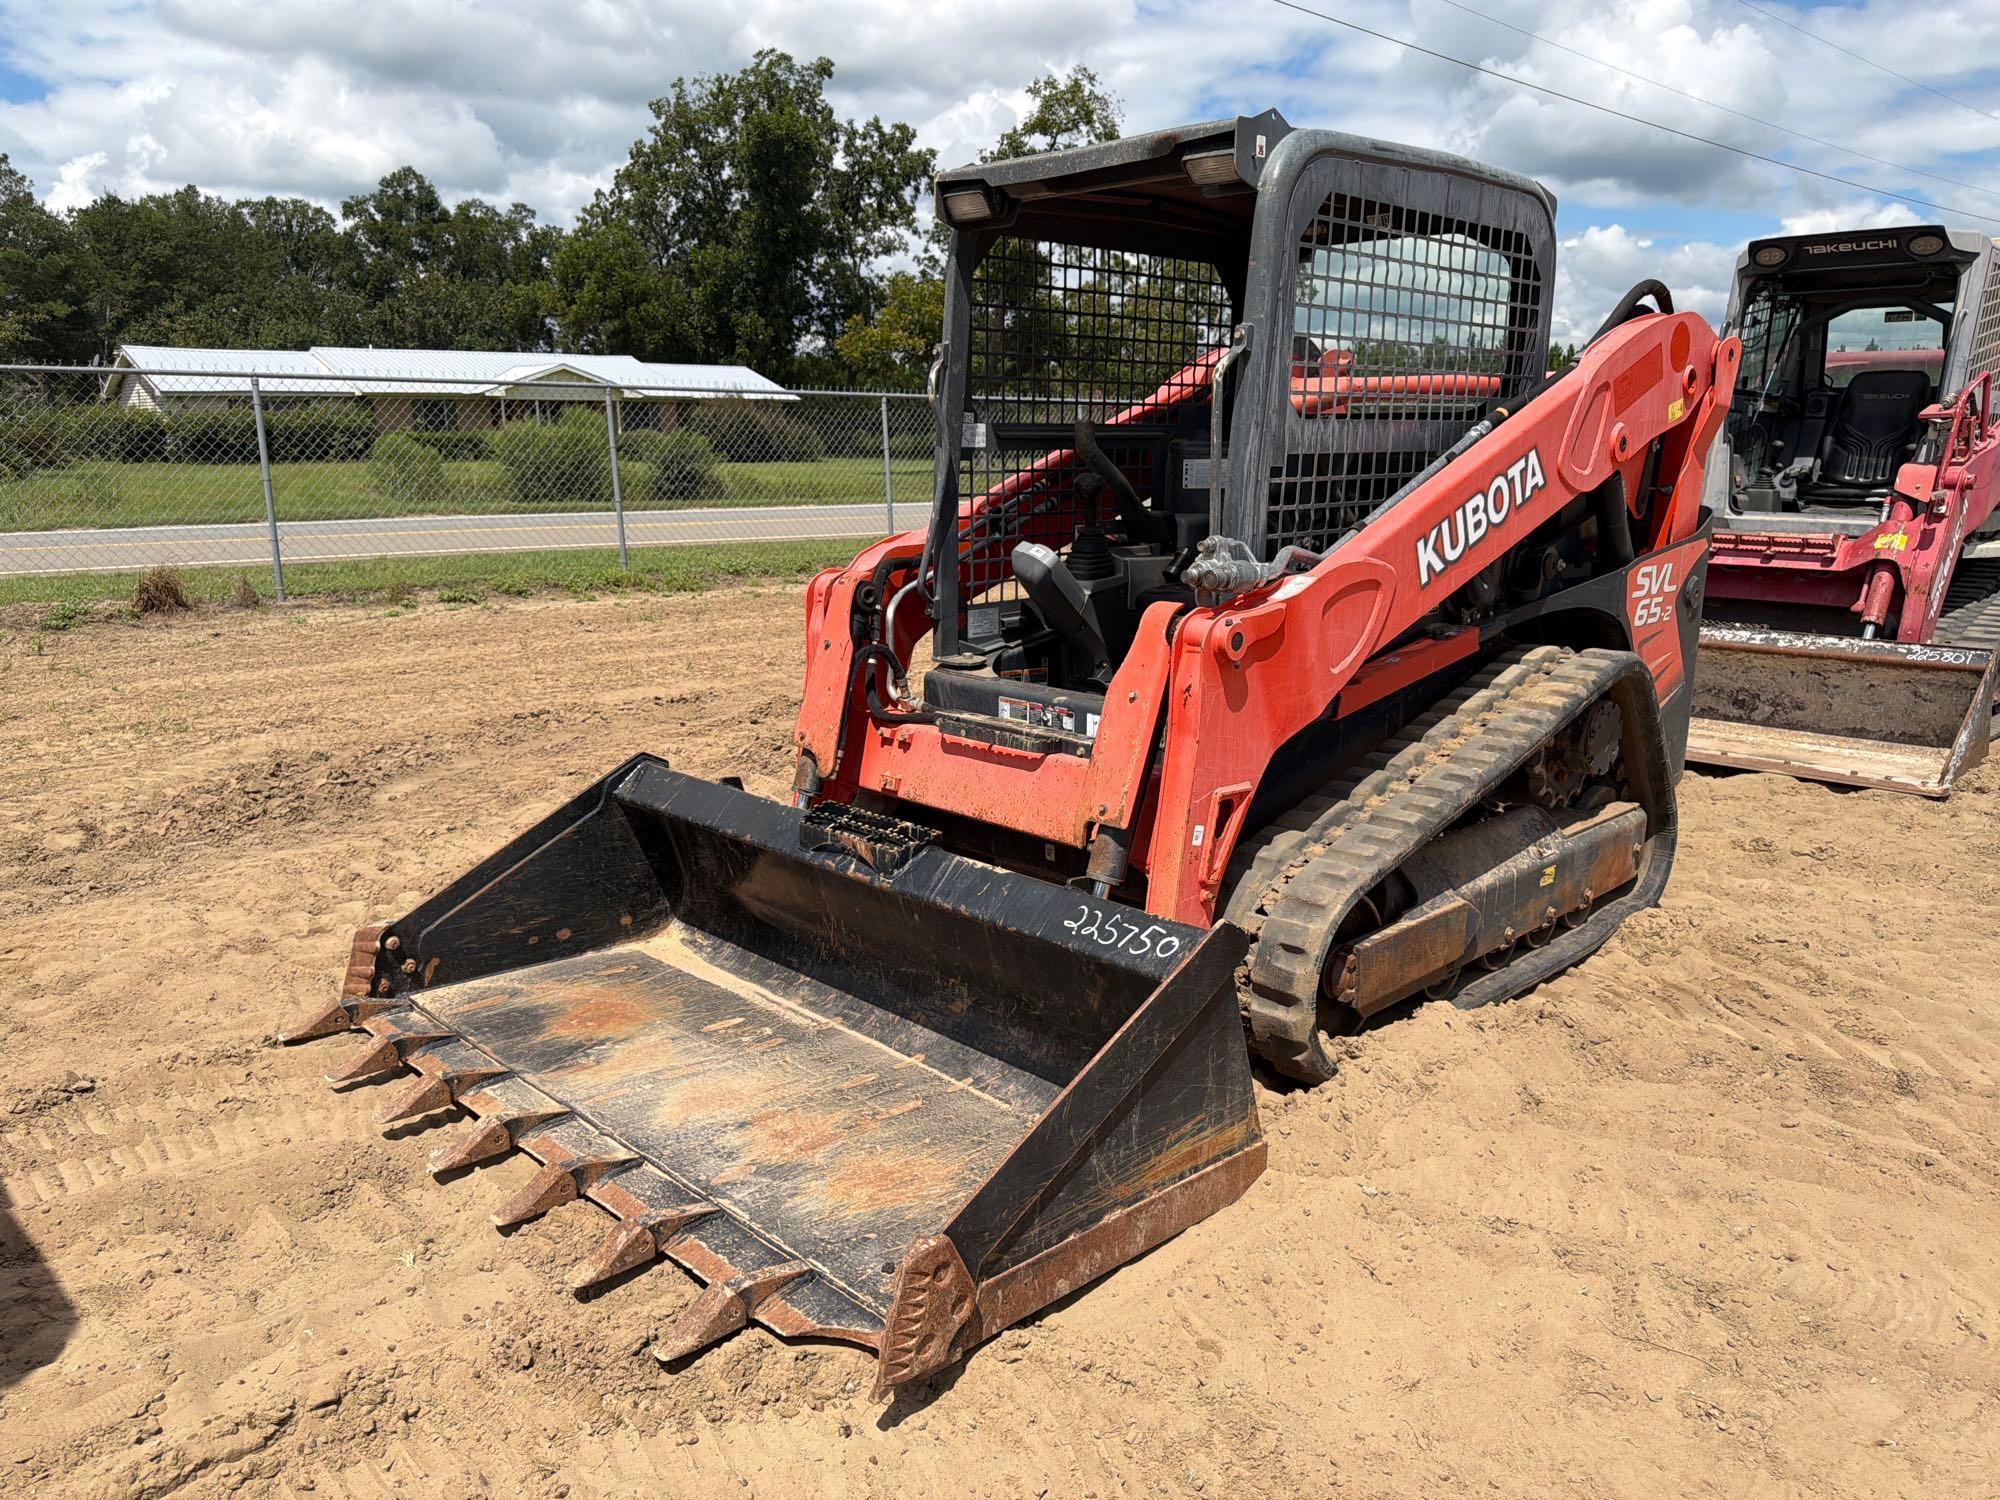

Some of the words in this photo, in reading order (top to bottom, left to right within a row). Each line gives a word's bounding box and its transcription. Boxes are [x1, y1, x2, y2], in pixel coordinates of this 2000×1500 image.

[1803, 239, 1898, 255] TAKEUCHI
[1415, 448, 1546, 588] KUBOTA
[1631, 562, 1677, 599] SVL
[1063, 905, 1180, 958] 225750
